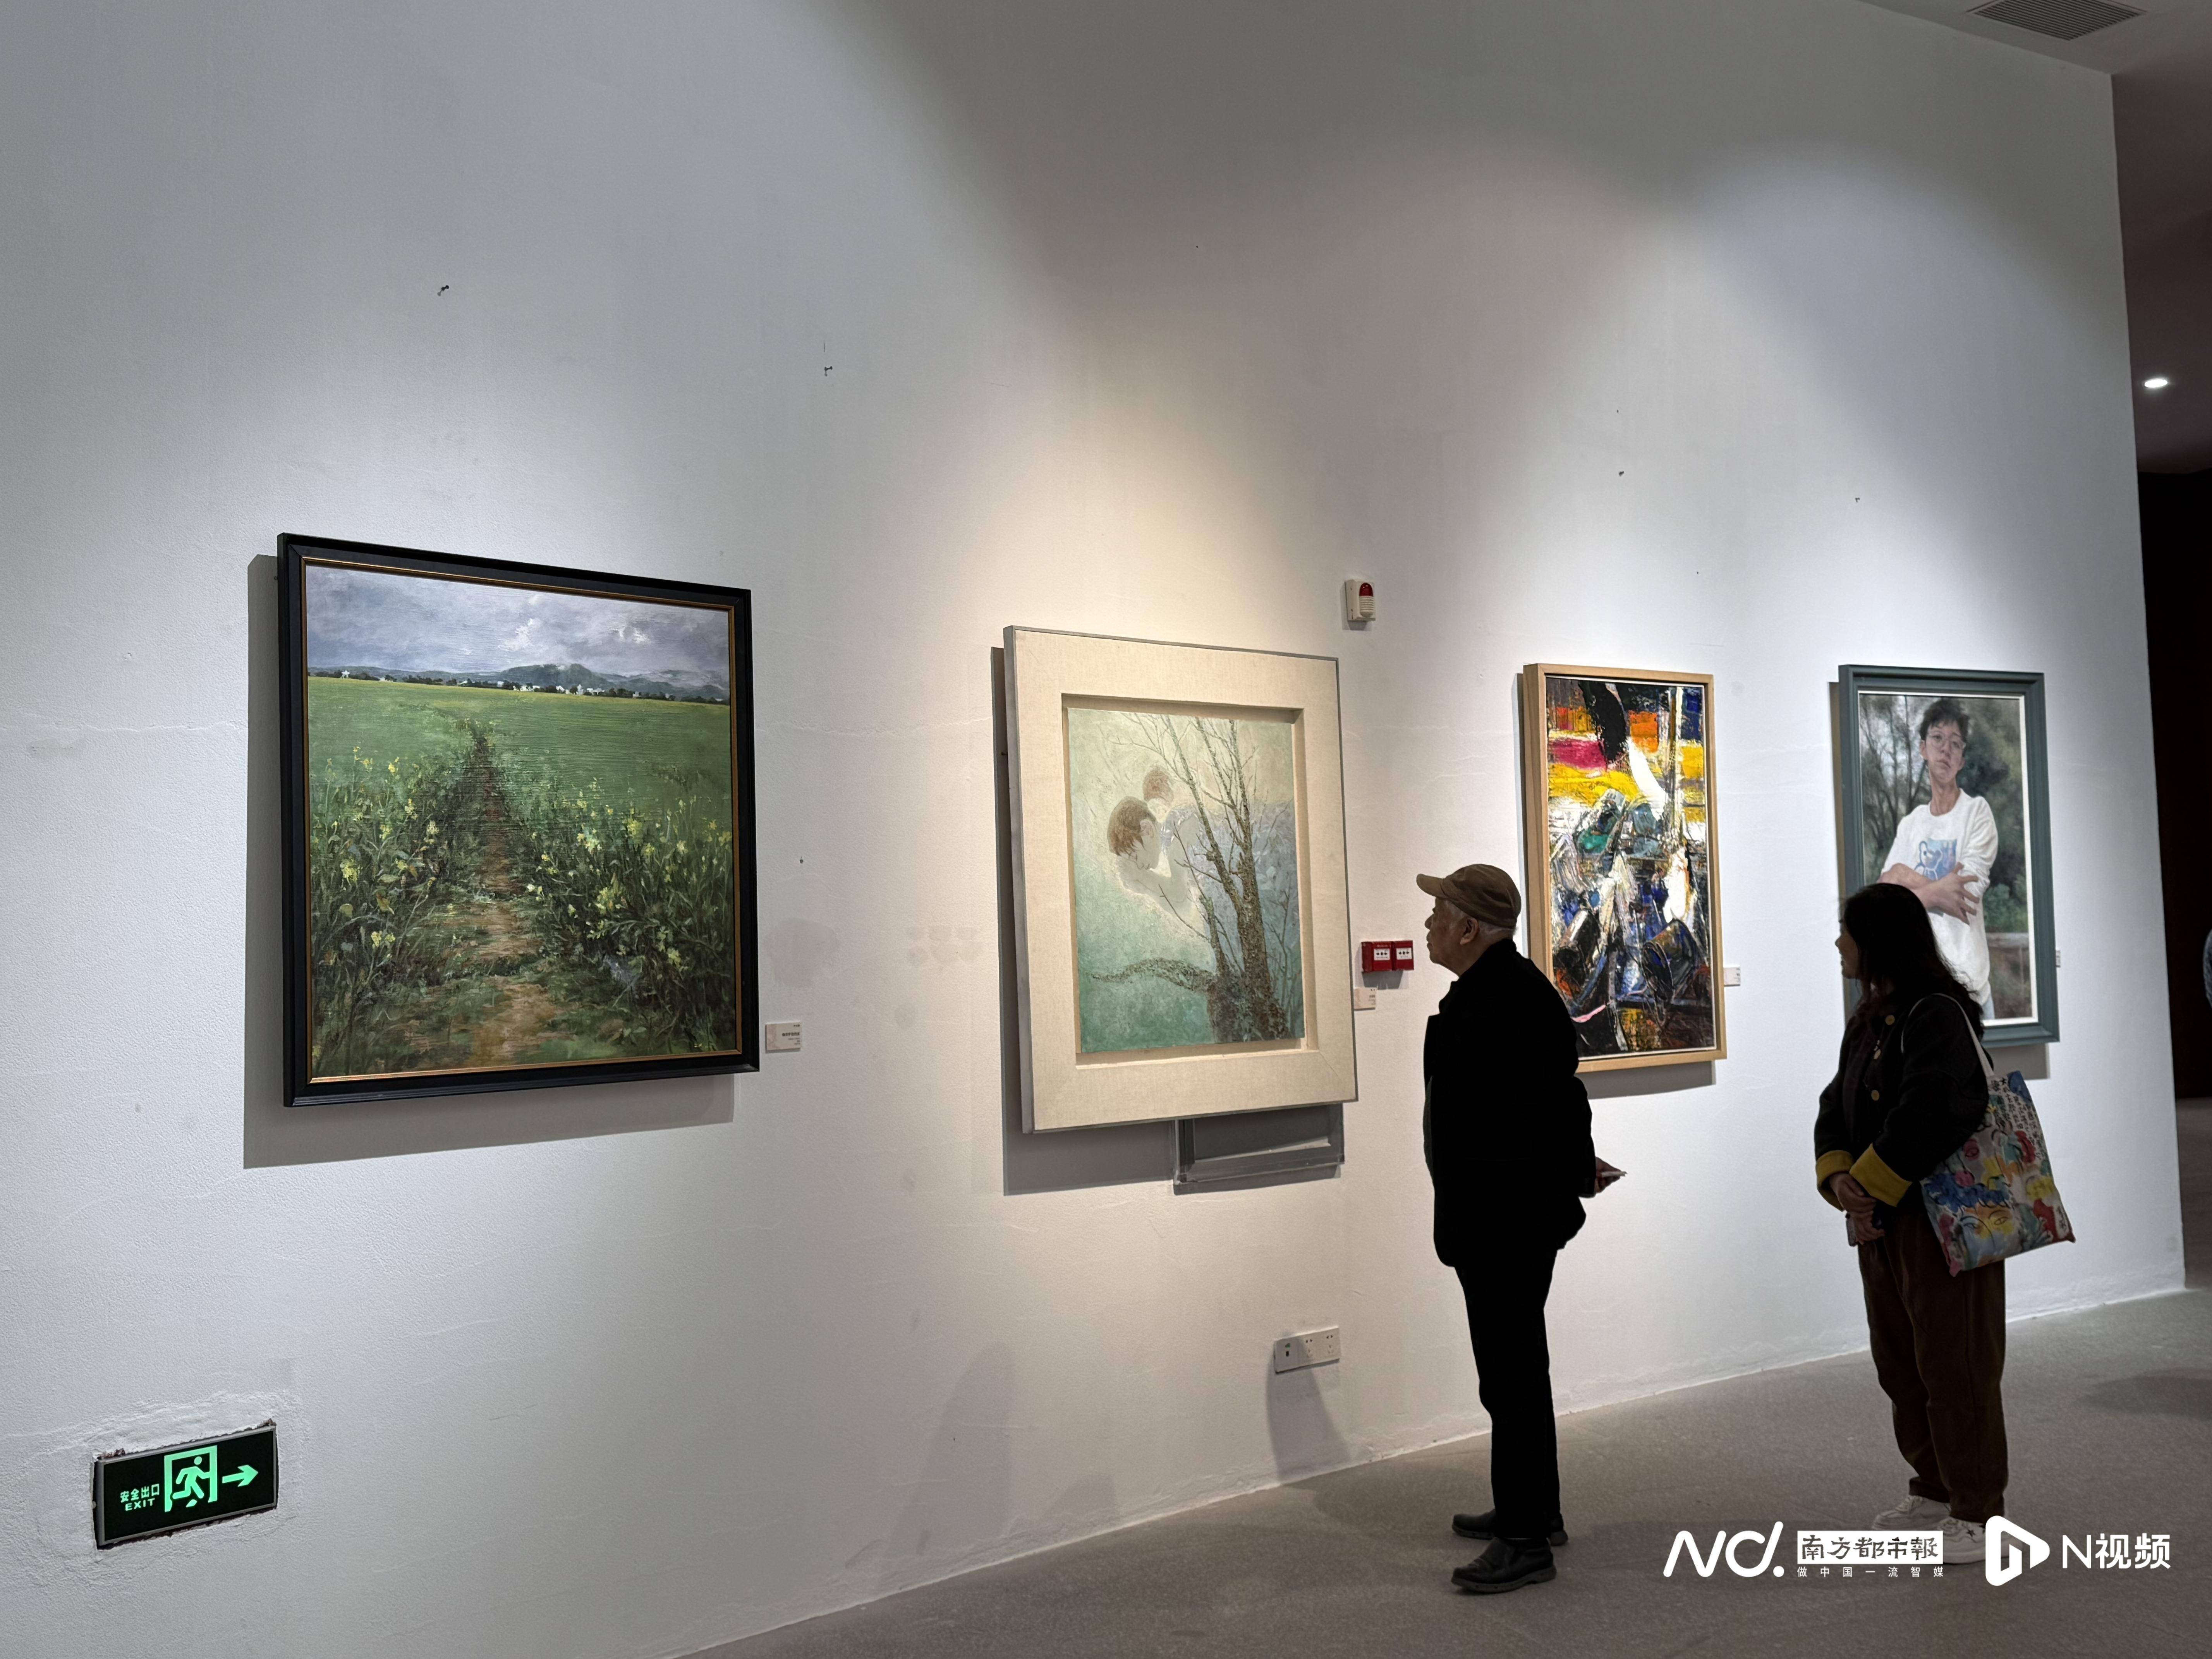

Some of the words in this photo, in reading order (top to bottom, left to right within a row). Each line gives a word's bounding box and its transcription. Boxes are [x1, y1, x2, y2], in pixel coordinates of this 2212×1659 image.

[120, 1483, 160, 1503] 安全出口
[125, 1498, 155, 1511] EXIT
